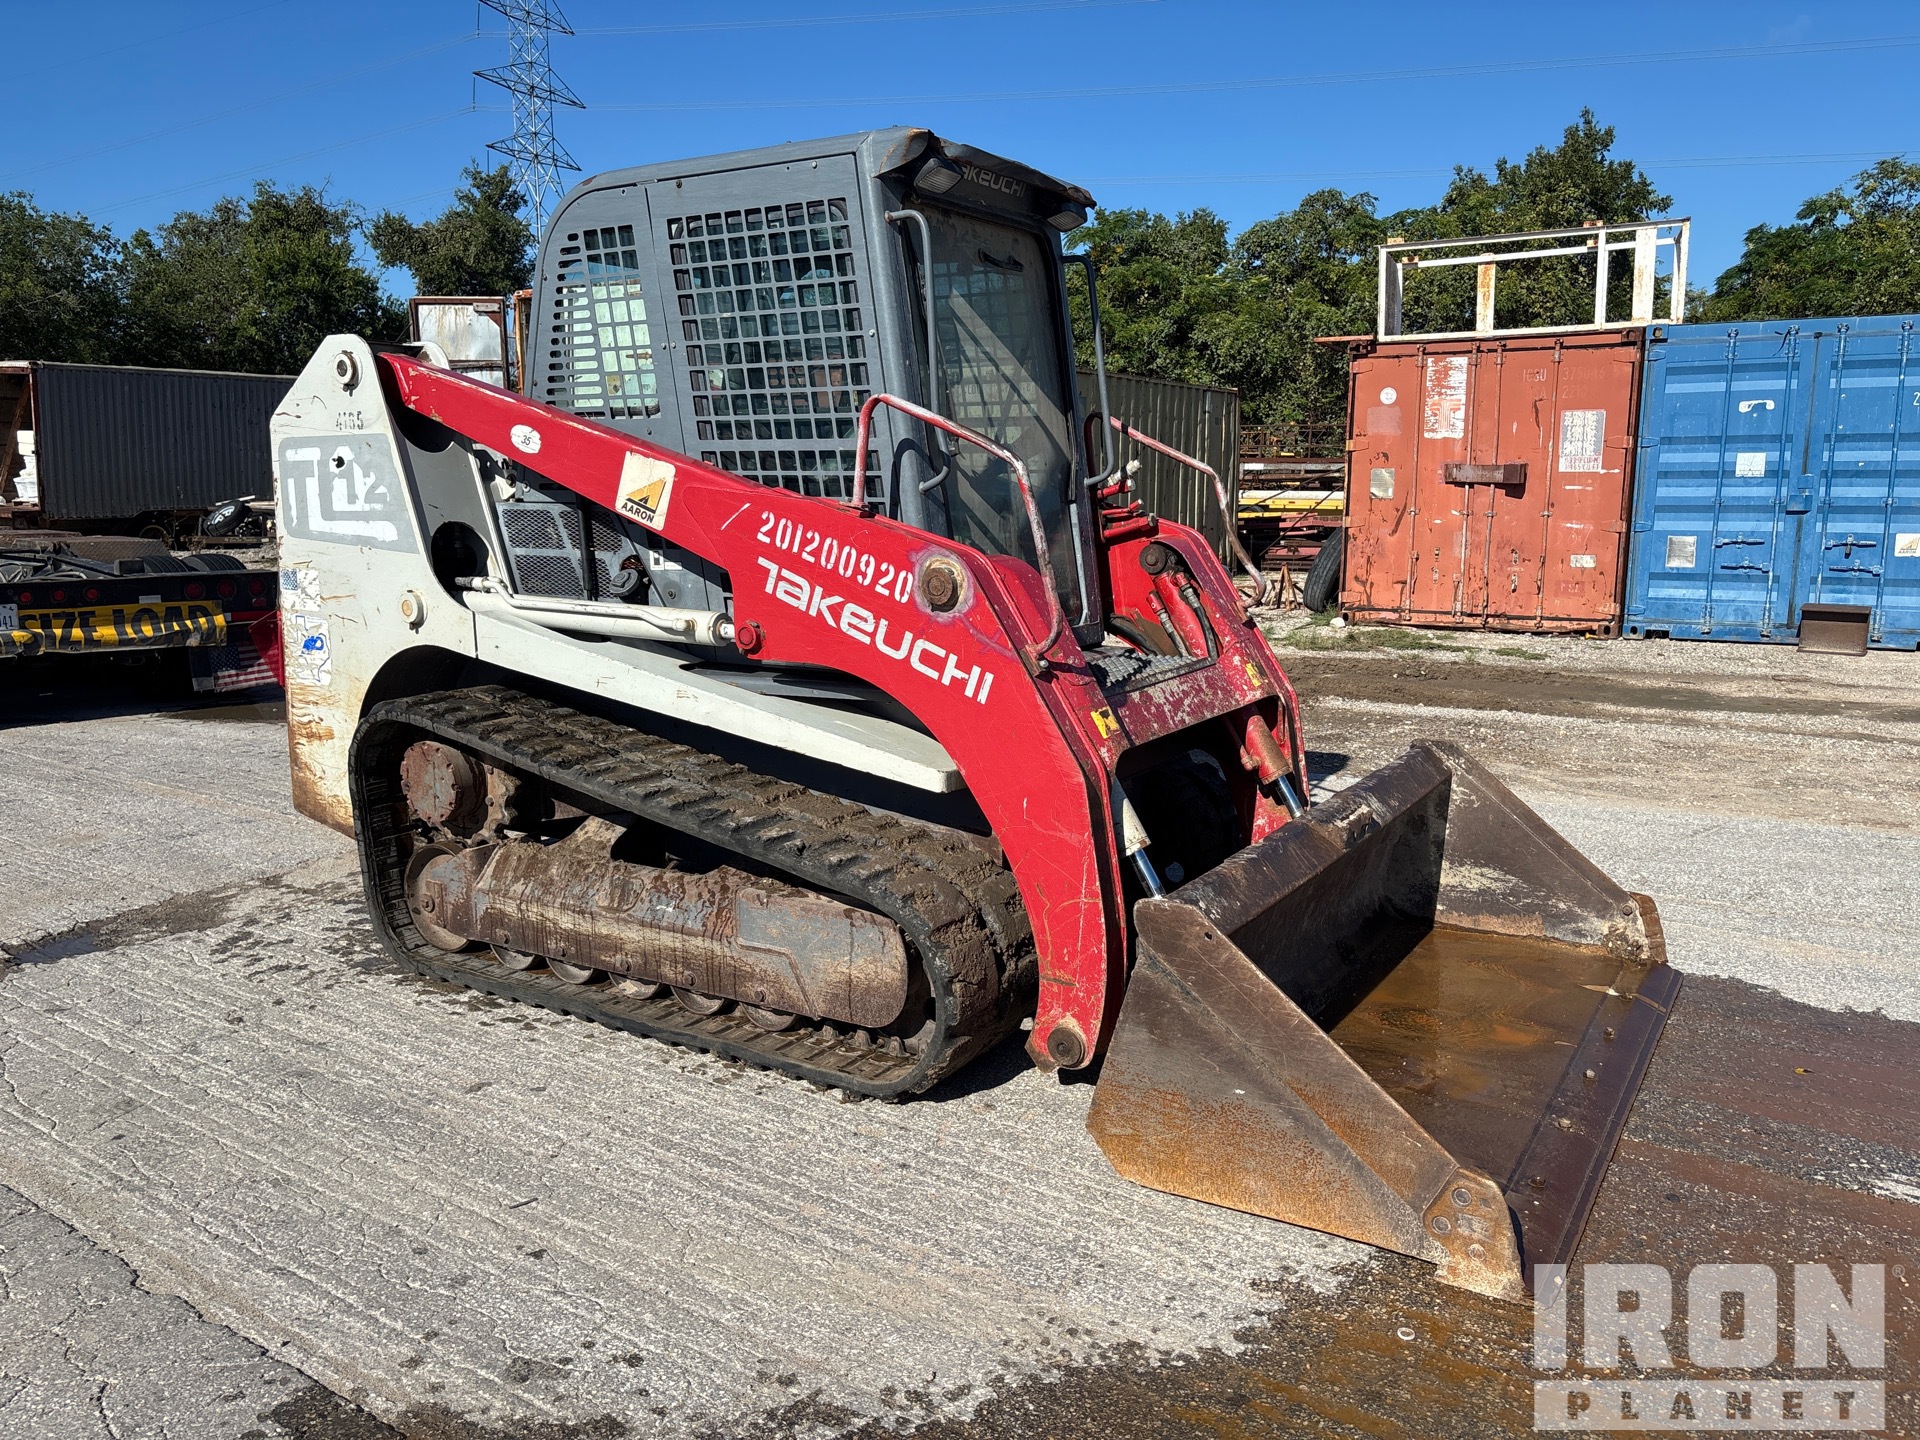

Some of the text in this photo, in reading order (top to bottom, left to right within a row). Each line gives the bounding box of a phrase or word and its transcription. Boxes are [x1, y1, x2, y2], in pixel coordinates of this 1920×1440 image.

[520, 434, 532, 446] 35
[621, 501, 655, 524] AARON
[756, 510, 914, 604] 201200920
[112, 604, 217, 645] LOAD
